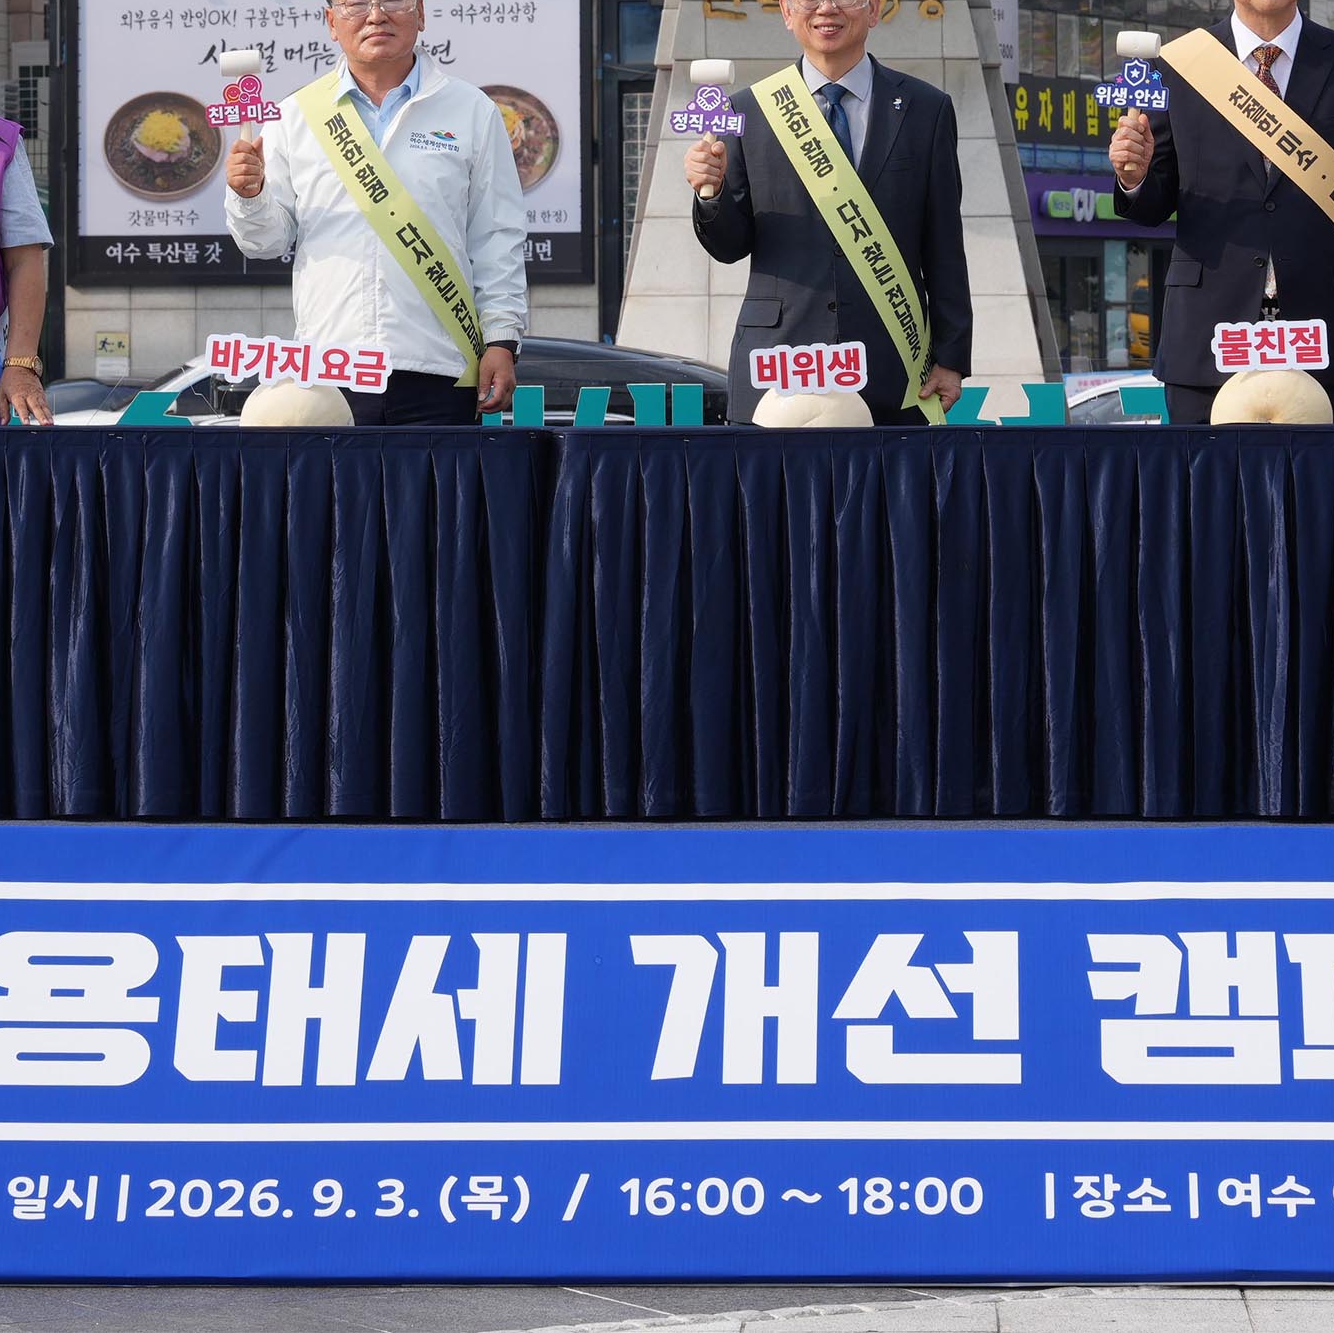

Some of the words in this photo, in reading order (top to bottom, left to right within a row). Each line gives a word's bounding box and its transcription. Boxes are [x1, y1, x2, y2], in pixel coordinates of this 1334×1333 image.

[120, 8, 174, 30] 외부음식
[179, 8, 238, 28] 반입OK!
[207, 102, 281, 127] 친절·미소
[1095, 86, 1167, 109] 위생·안심
[671, 110, 744, 135] 정직·신뢰
[1227, 83, 1283, 138] 친절한
[1275, 129, 1319, 172] 미소
[770, 83, 813, 141] 깨끗한
[798, 135, 835, 179] 환경
[835, 199, 873, 244] 다시
[860, 240, 896, 286] 찾는
[324, 112, 366, 168] 깨끗한
[353, 162, 390, 205] 환경
[395, 222, 435, 266] 다시
[424, 260, 460, 304] 찾는
[105, 242, 141, 264] 여수
[145, 241, 200, 265] 특산물
[203, 241, 224, 264] 갓
[210, 338, 312, 384] 바가지
[319, 346, 388, 388] 요금
[1216, 323, 1326, 366] 불친절
[755, 346, 862, 391] 비위생
[629, 930, 1023, 1086] 개선
[6, 1174, 100, 1222] 일시
[144, 1176, 295, 1220] 2026.
[311, 1176, 357, 1219] 9.
[373, 1176, 420, 1219] 3.
[439, 1174, 532, 1224] (목)
[619, 1176, 765, 1217] 16:00
[838, 1176, 985, 1217] 18:00
[1071, 1172, 1173, 1219] 장소
[1216, 1173, 1317, 1219] 여수
